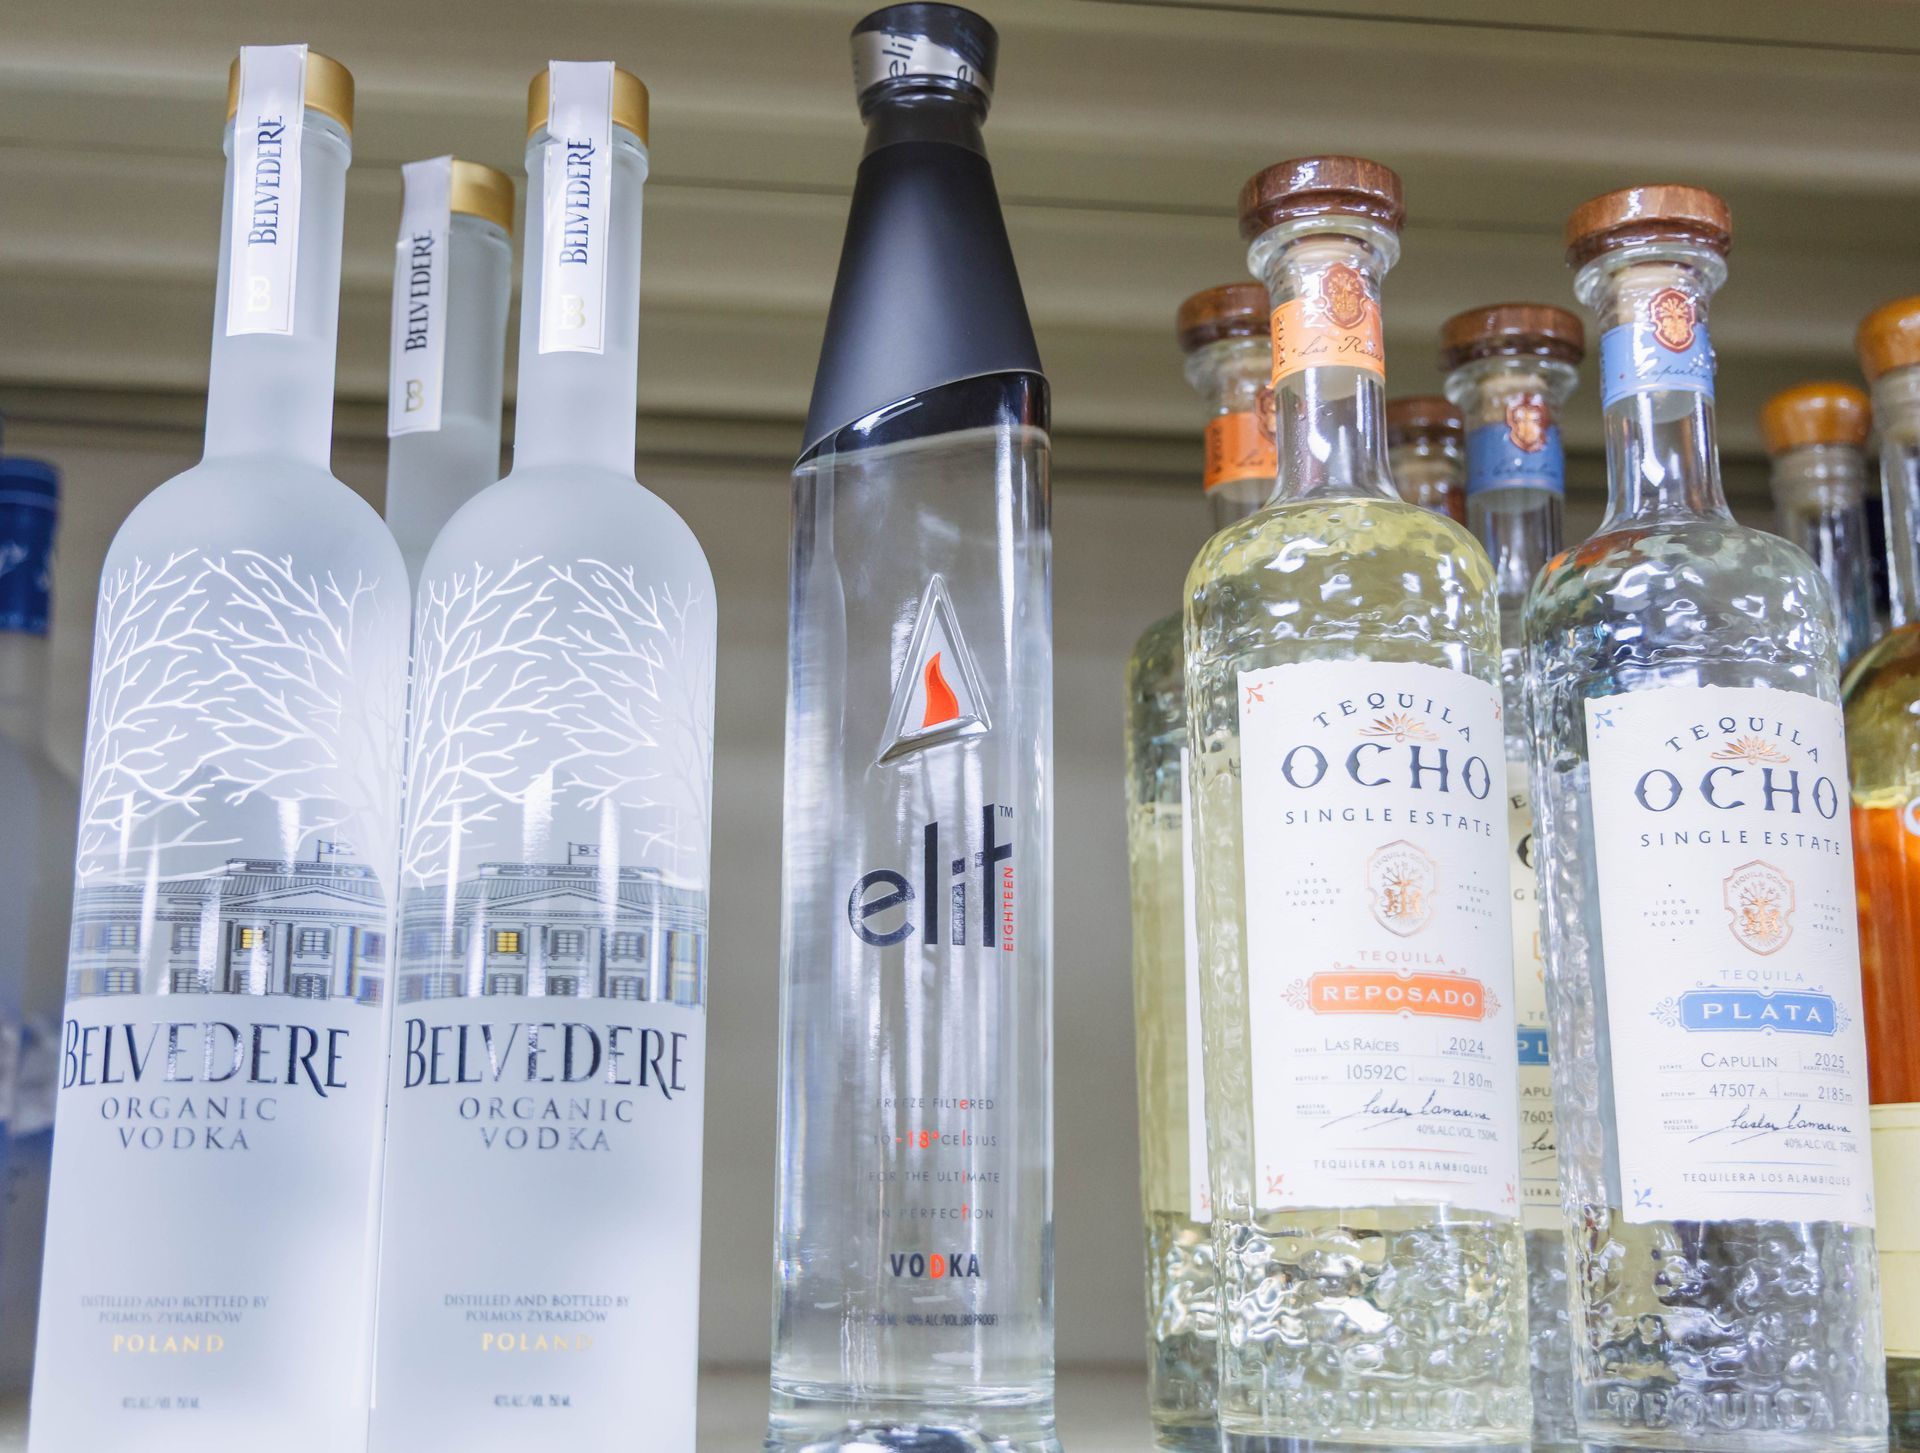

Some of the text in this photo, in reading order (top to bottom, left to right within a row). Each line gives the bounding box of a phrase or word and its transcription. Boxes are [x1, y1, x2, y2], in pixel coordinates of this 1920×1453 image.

[248, 115, 286, 248] BELVEDERE
[559, 137, 597, 266] BELVEDERE
[405, 230, 435, 353] BELVEDERE
[1313, 692, 1472, 743] TEQUILA
[1665, 716, 1819, 763] TEQUILA
[1281, 742, 1491, 801] OCHO
[1634, 766, 1838, 820] OCHO
[1285, 807, 1491, 837] SINGLE ESTATE
[1640, 829, 1841, 856] SINGLE ESTATE
[848, 804, 1013, 948] elit
[1003, 866, 1014, 952] EIGHTEEN
[1358, 950, 1446, 965] TEQUILA
[1720, 969, 1805, 983] TEQUILA
[1322, 985, 1477, 1007] REPOSADO
[1702, 1003, 1823, 1024] PLATA
[1449, 1036, 1485, 1054] 2024
[62, 1018, 350, 1098] BELVEDERE
[403, 1017, 688, 1100] BELVEDERE
[1700, 1052, 1778, 1068] CAPULIN
[1814, 1052, 1845, 1069] 2025
[1346, 1064, 1407, 1081] 10592C
[1452, 1070, 1493, 1089] 2180m
[1709, 1083, 1755, 1098] 47507
[101, 1096, 278, 1121] ORGANIC
[459, 1097, 634, 1123] ORGANIC
[118, 1126, 249, 1150] VODKA
[480, 1126, 611, 1151] VODKA
[905, 1171, 929, 1182] THE
[1313, 1159, 1489, 1176] TEQUILERA LOS ALAMBIQUES
[1683, 1172, 1851, 1187] TEQUILERA LOS ALAMBIQUES
[890, 1251, 981, 1280] VODKA
[144, 1295, 178, 1309] AND
[182, 1294, 249, 1309] BOTTLED
[253, 1295, 269, 1309] BY
[515, 1294, 548, 1307] AND
[552, 1294, 613, 1308] BOTTLED
[616, 1295, 631, 1307] BY
[111, 1333, 225, 1353] POLAND
[482, 1331, 593, 1352] POLAND
